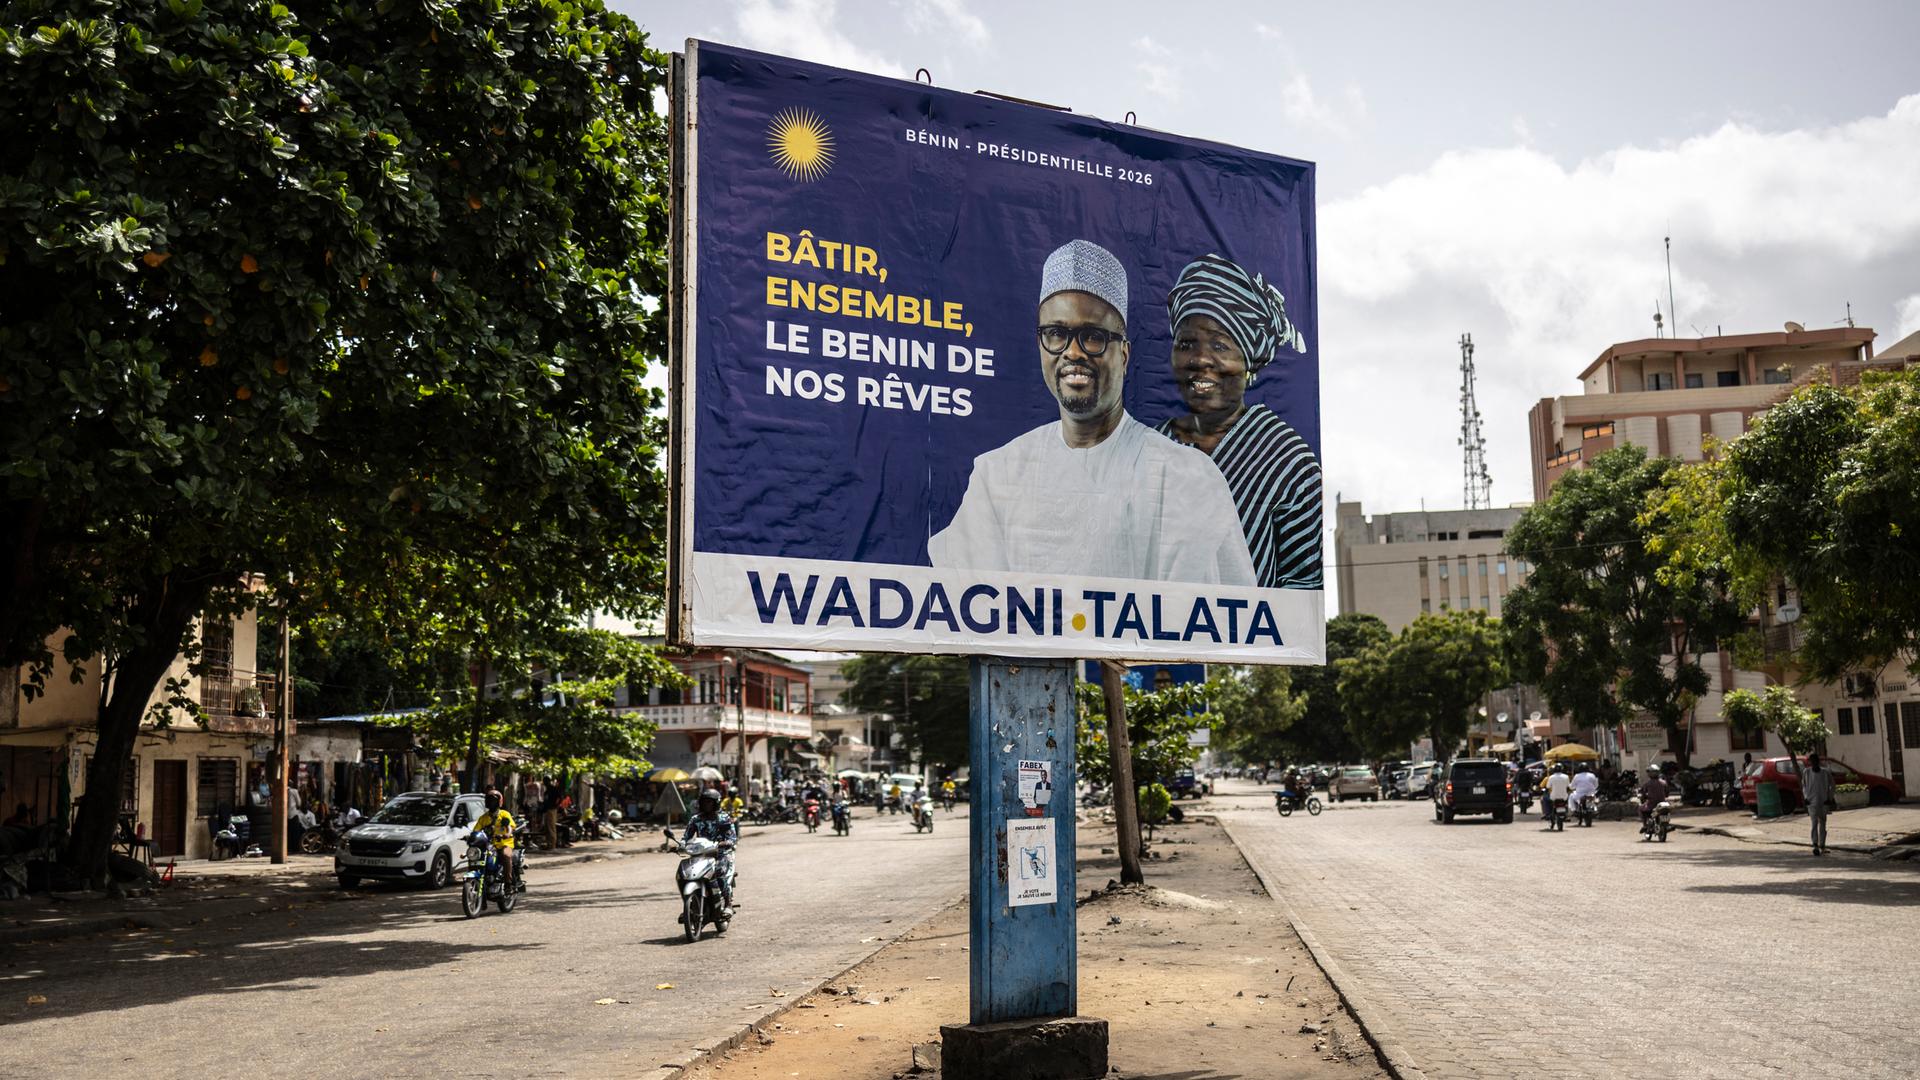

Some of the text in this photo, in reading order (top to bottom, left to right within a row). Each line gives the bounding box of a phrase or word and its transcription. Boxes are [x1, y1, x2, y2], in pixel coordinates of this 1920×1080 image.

[906, 127, 960, 151] BÉNIN
[977, 141, 1113, 179] PRÉSIDENTIELLE
[1118, 168, 1153, 186] 2026
[766, 229, 888, 283] BÂTIR,
[766, 275, 975, 339] ENSEMBLE,
[766, 320, 996, 377] LE BENIN DE
[766, 362, 973, 417] NOS RÊVES
[746, 570, 1284, 646] WADAGNI TALATA
